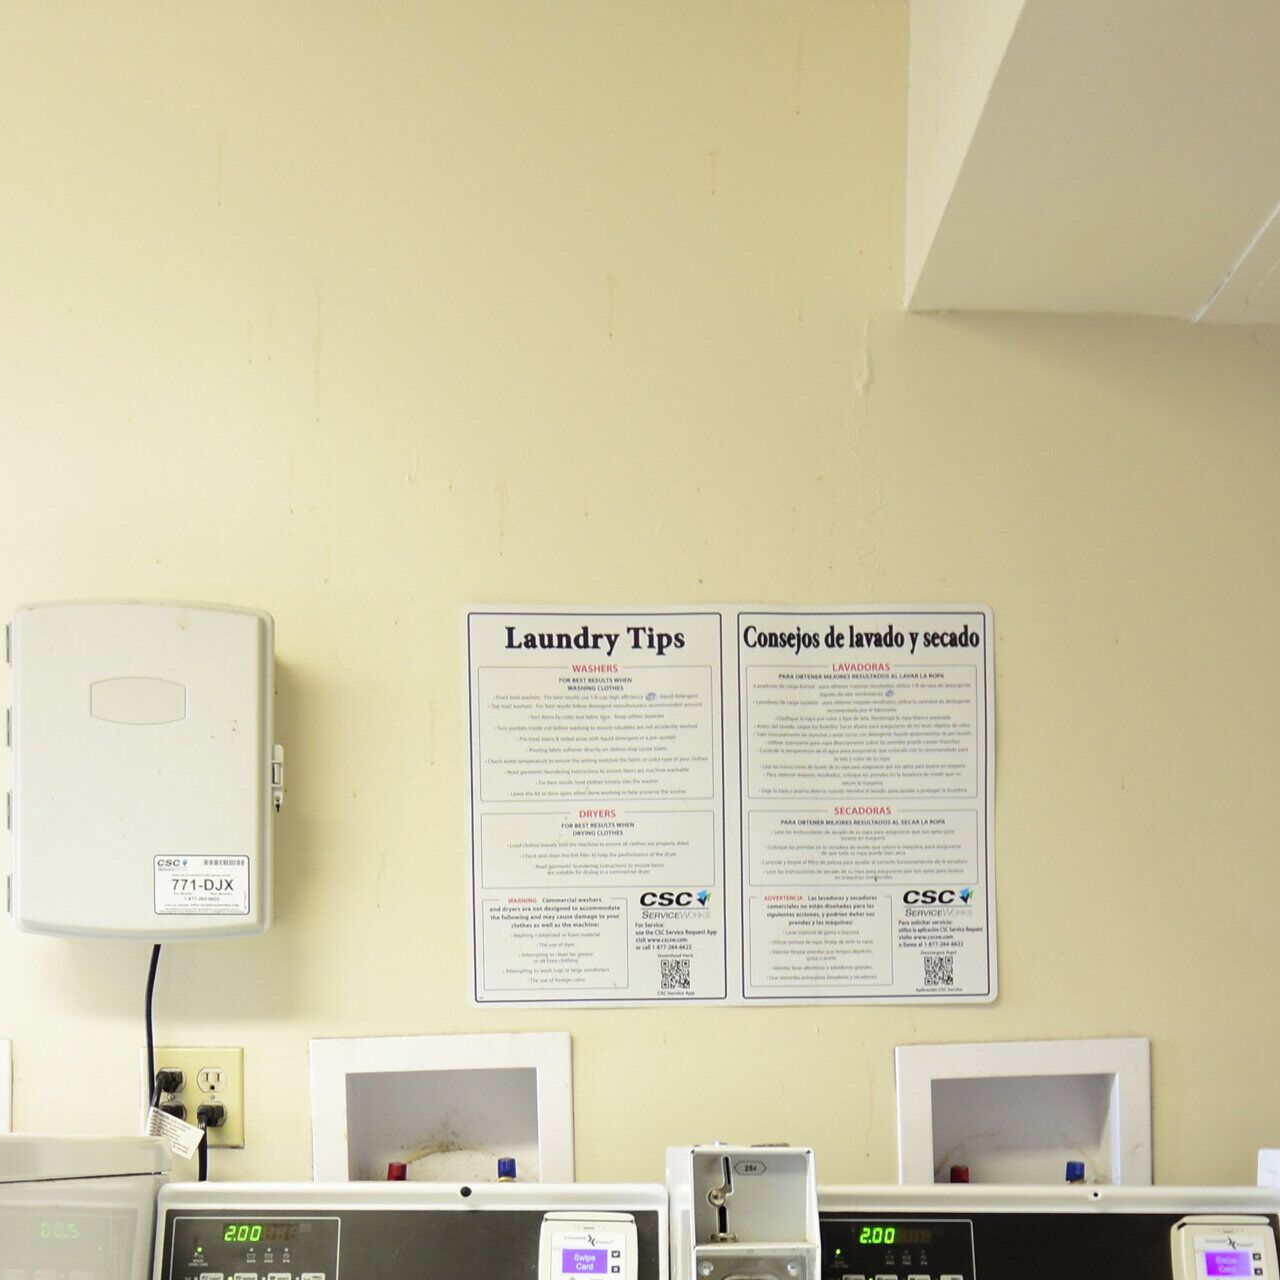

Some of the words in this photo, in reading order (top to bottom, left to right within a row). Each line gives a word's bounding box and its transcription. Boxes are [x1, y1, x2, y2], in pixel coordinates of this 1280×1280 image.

[505, 625, 620, 656] Laundry
[627, 626, 685, 655] Tips
[743, 625, 820, 655] Consejos
[825, 625, 844, 648] de
[849, 625, 904, 648] lavado
[911, 632, 919, 654] y
[923, 625, 980, 648] secado
[572, 665, 618, 673] WASHERS
[832, 663, 890, 672] LAVADORAS
[579, 810, 616, 818] DRYERS
[834, 807, 891, 816] SECADORAS
[172, 879, 234, 891] 771-DJX
[640, 892, 693, 907] CSC
[903, 890, 955, 904] CSC
[224, 1225, 262, 1241] 2.00
[859, 1227, 895, 1244] 2.00
[574, 1254, 596, 1262] Swipe
